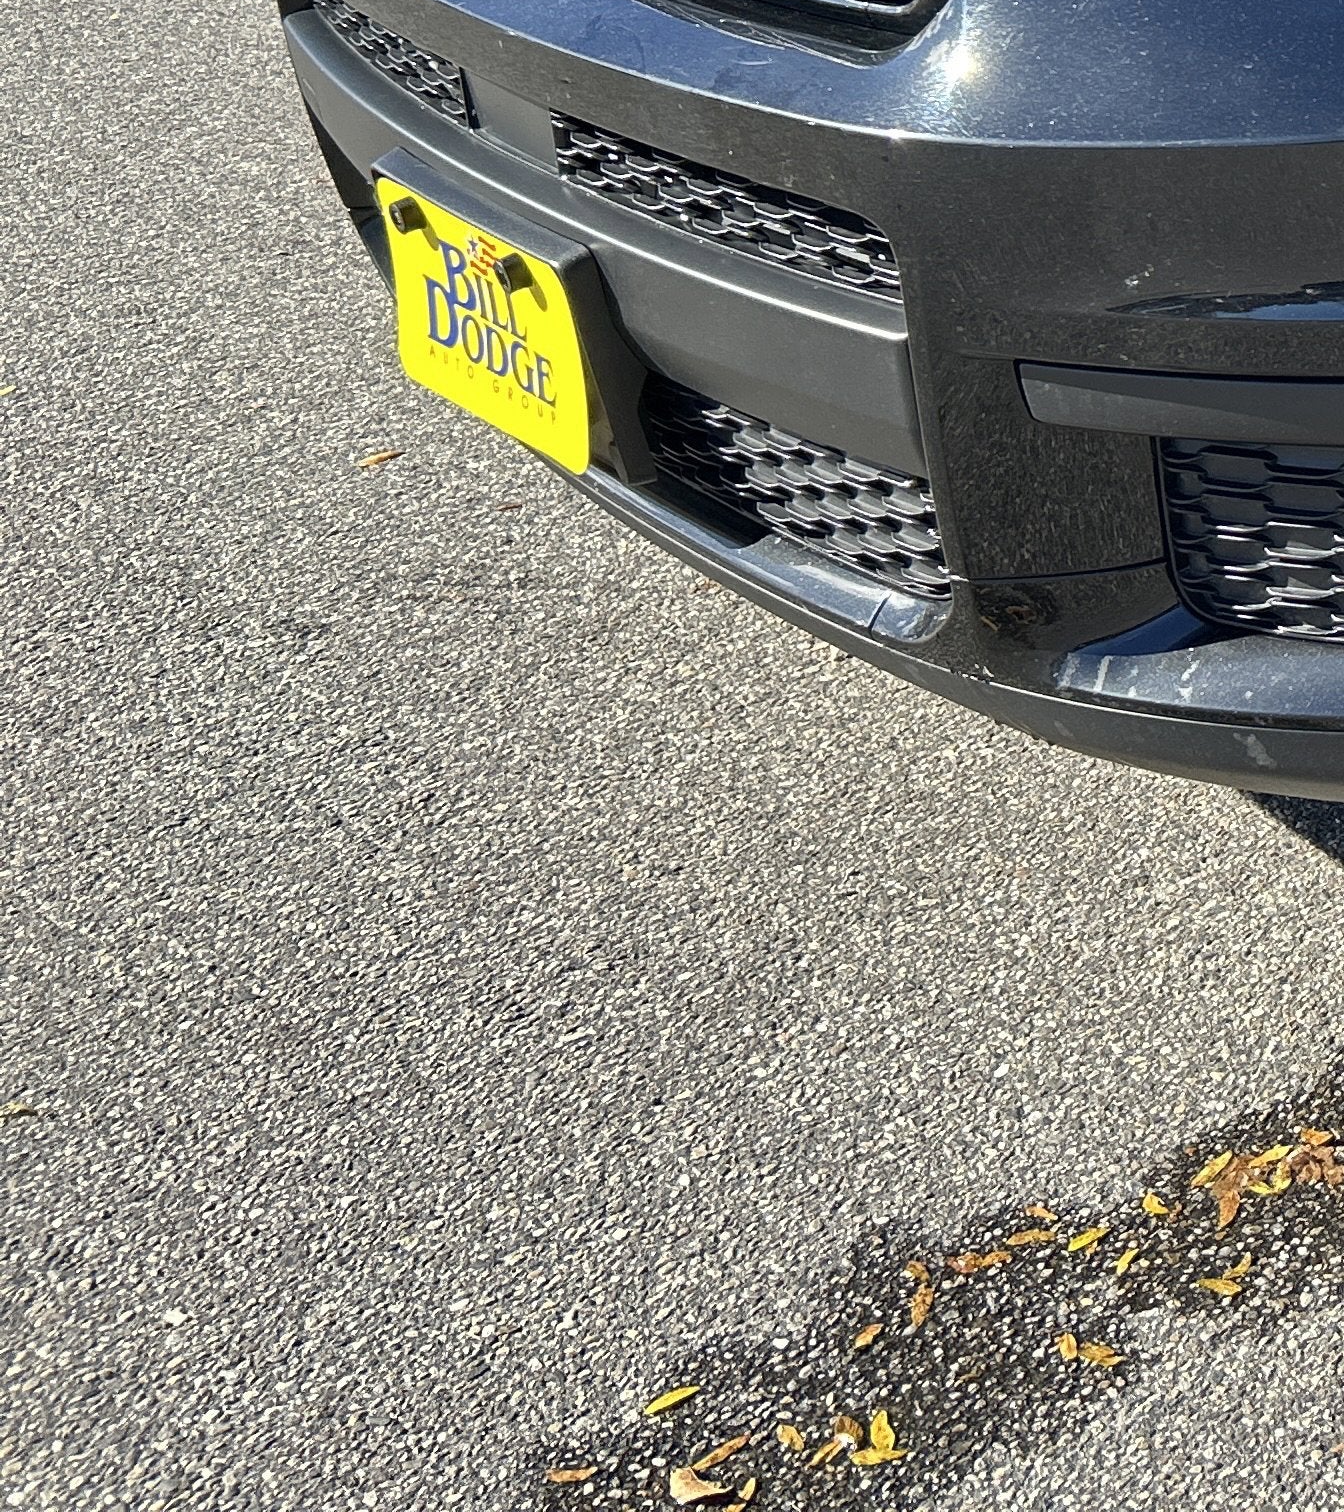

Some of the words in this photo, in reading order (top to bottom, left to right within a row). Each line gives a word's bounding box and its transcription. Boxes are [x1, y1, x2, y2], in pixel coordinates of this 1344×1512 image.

[422, 274, 557, 408] DODGE
[438, 238, 527, 342] BILL
[429, 346, 475, 379] AUTO
[493, 379, 556, 425] GROUP
